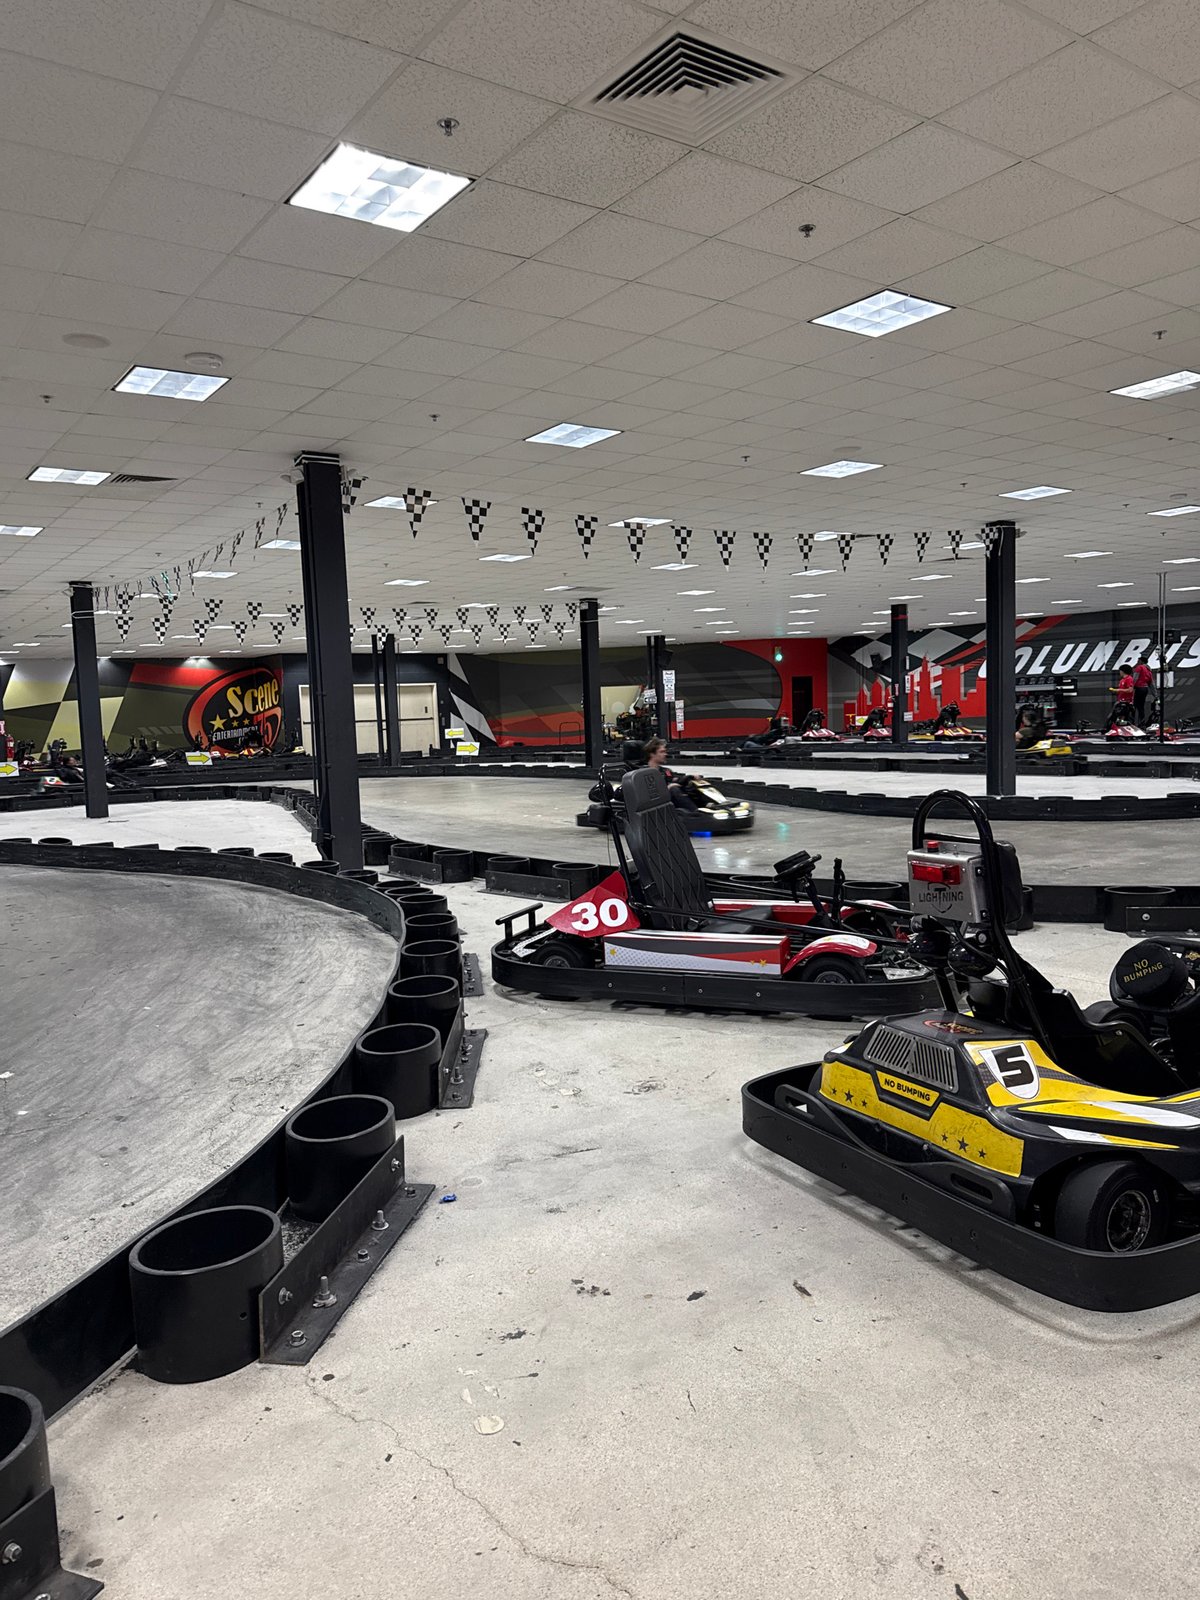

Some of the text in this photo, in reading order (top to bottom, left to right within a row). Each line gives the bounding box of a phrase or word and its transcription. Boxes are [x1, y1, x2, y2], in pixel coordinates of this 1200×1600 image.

[978, 634, 1200, 678] OLUMBUS
[226, 678, 279, 718] Scene
[918, 887, 964, 906] LIGHTNING
[571, 898, 628, 932] 30
[1123, 962, 1163, 983] BUMPING
[1133, 958, 1149, 971] NO
[991, 1045, 1034, 1088] 5
[884, 1078, 931, 1102] NO BUMPING
